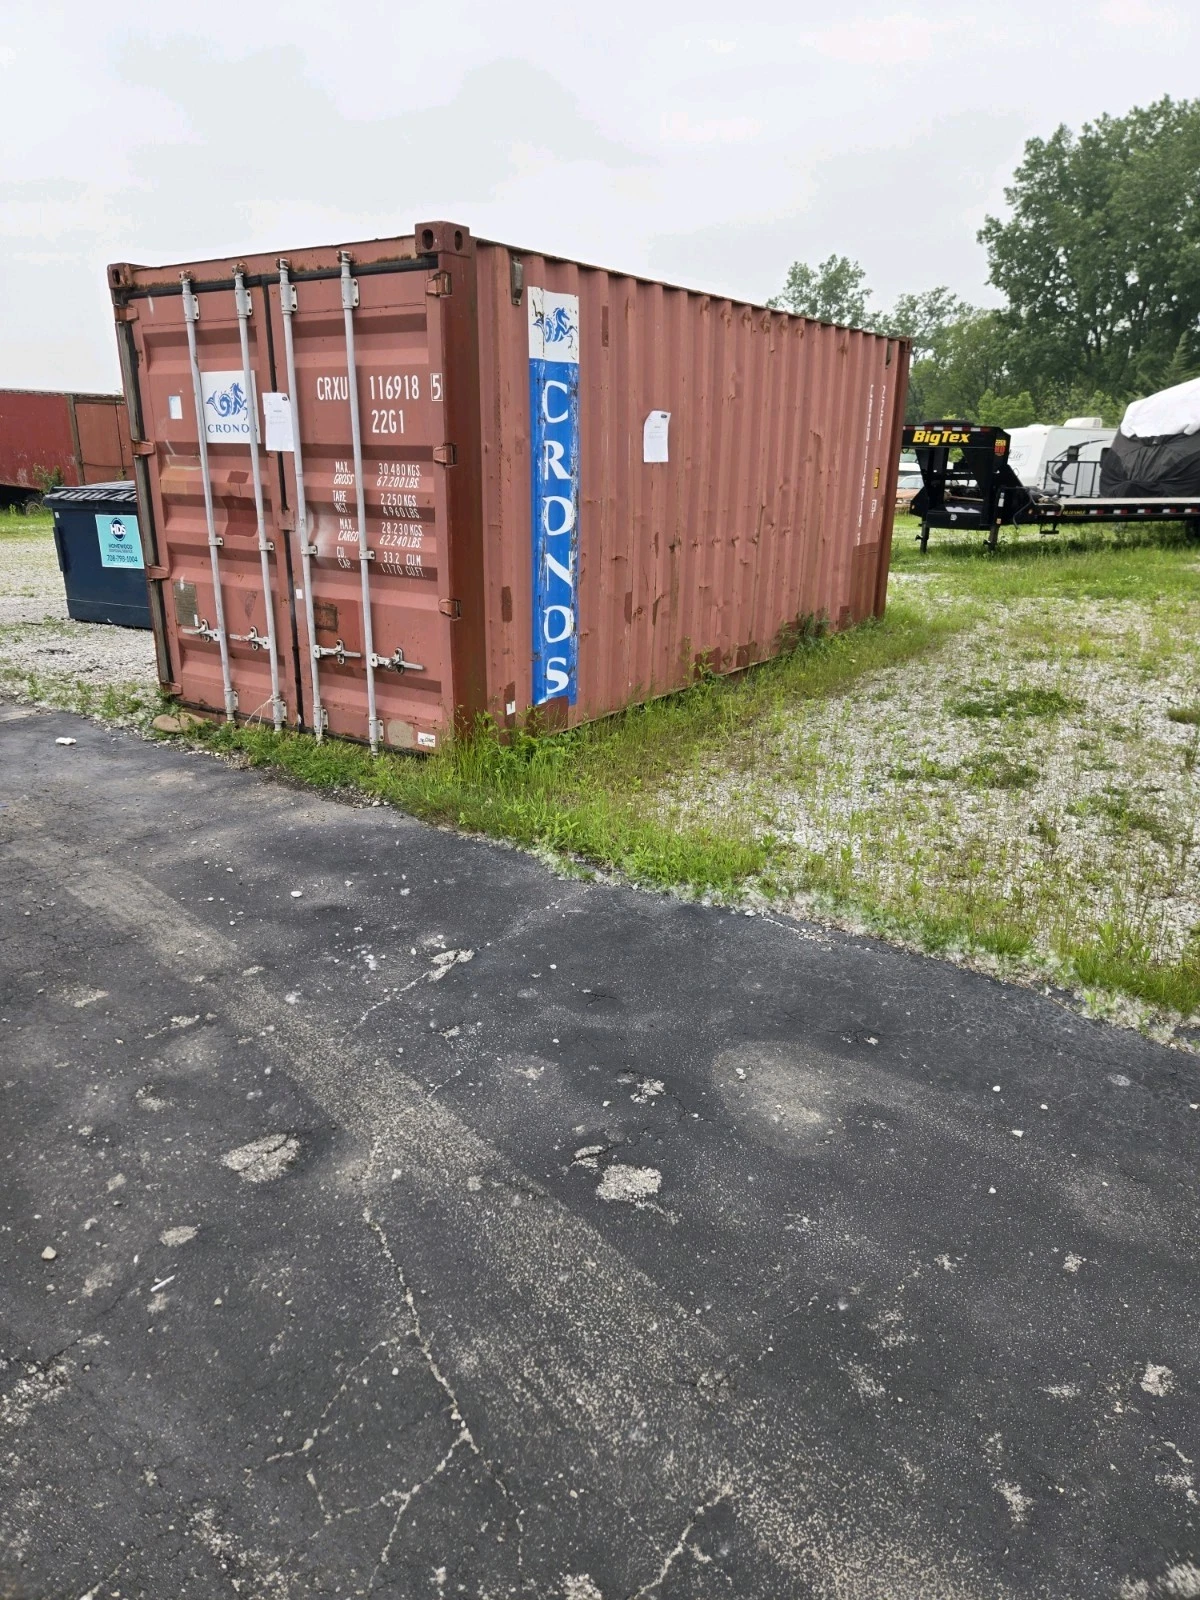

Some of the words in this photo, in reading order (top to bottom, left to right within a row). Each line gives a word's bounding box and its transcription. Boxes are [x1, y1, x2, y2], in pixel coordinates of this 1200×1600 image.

[317, 376, 349, 401] CRXU
[369, 374, 420, 400] 116918
[432, 373, 442, 401] 5
[371, 409, 405, 434] 22G1
[912, 430, 971, 446] BigTex
[335, 461, 351, 473] MAX.
[378, 463, 406, 476] 30.480
[407, 464, 422, 477] KGS.
[333, 473, 354, 485] GROSS
[376, 475, 405, 488] 67.200
[404, 477, 420, 489] LBS.
[332, 490, 347, 502] TARE
[380, 493, 402, 505] 2.250
[403, 494, 419, 507] KGS.
[404, 507, 422, 519] LBS.
[109, 523, 126, 535] HDS
[339, 518, 355, 530] MAX.
[381, 521, 408, 535] 28.230
[409, 524, 424, 537] KGS.
[337, 530, 359, 542] CARGO
[379, 535, 408, 547] 62.240
[407, 536, 422, 549] LBS.
[541, 378, 575, 696] CRONOS
[336, 546, 347, 558] CU.
[383, 551, 400, 564] 33.2
[338, 558, 354, 569] CAP.
[380, 563, 403, 575] 1.170
